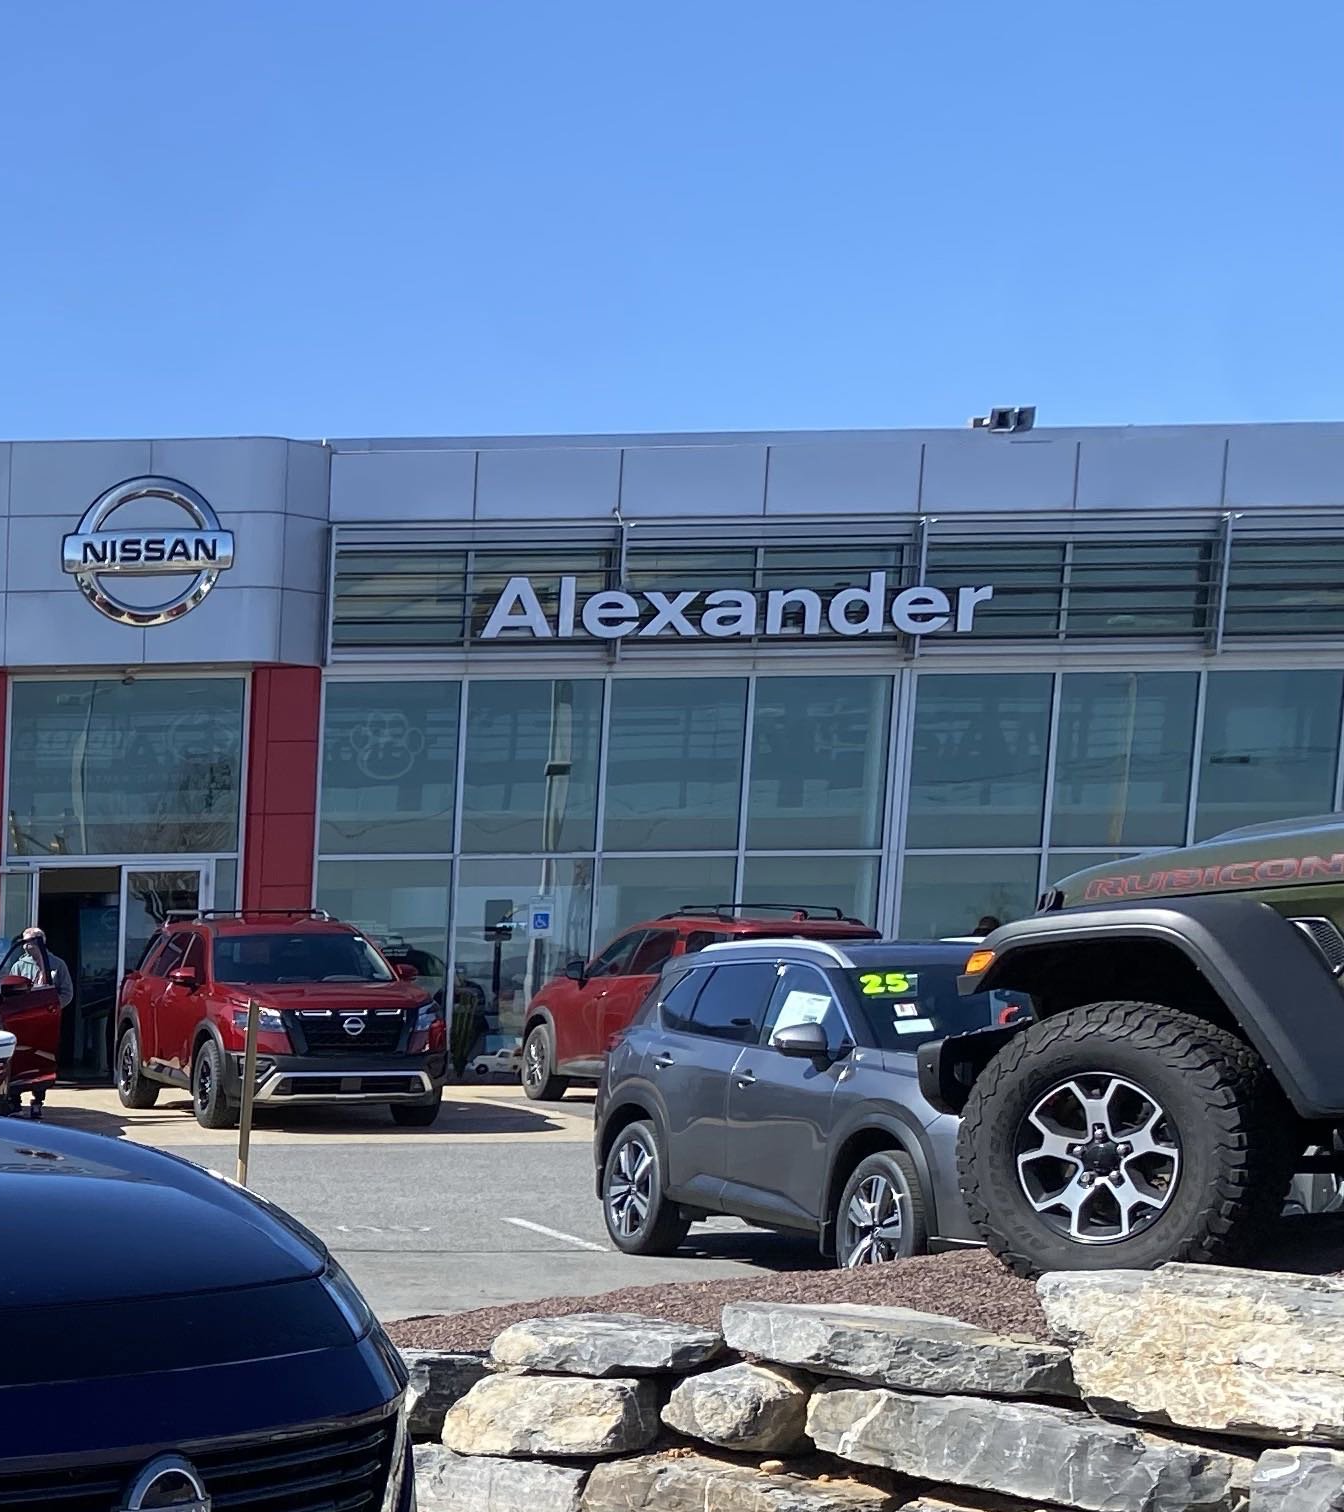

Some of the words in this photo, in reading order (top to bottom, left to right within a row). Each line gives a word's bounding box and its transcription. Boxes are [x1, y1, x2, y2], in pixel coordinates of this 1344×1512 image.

[82, 537, 217, 564] NISSAN
[479, 570, 993, 639] Alexander
[1084, 853, 1344, 901] RUBICON
[859, 973, 909, 994] 25
